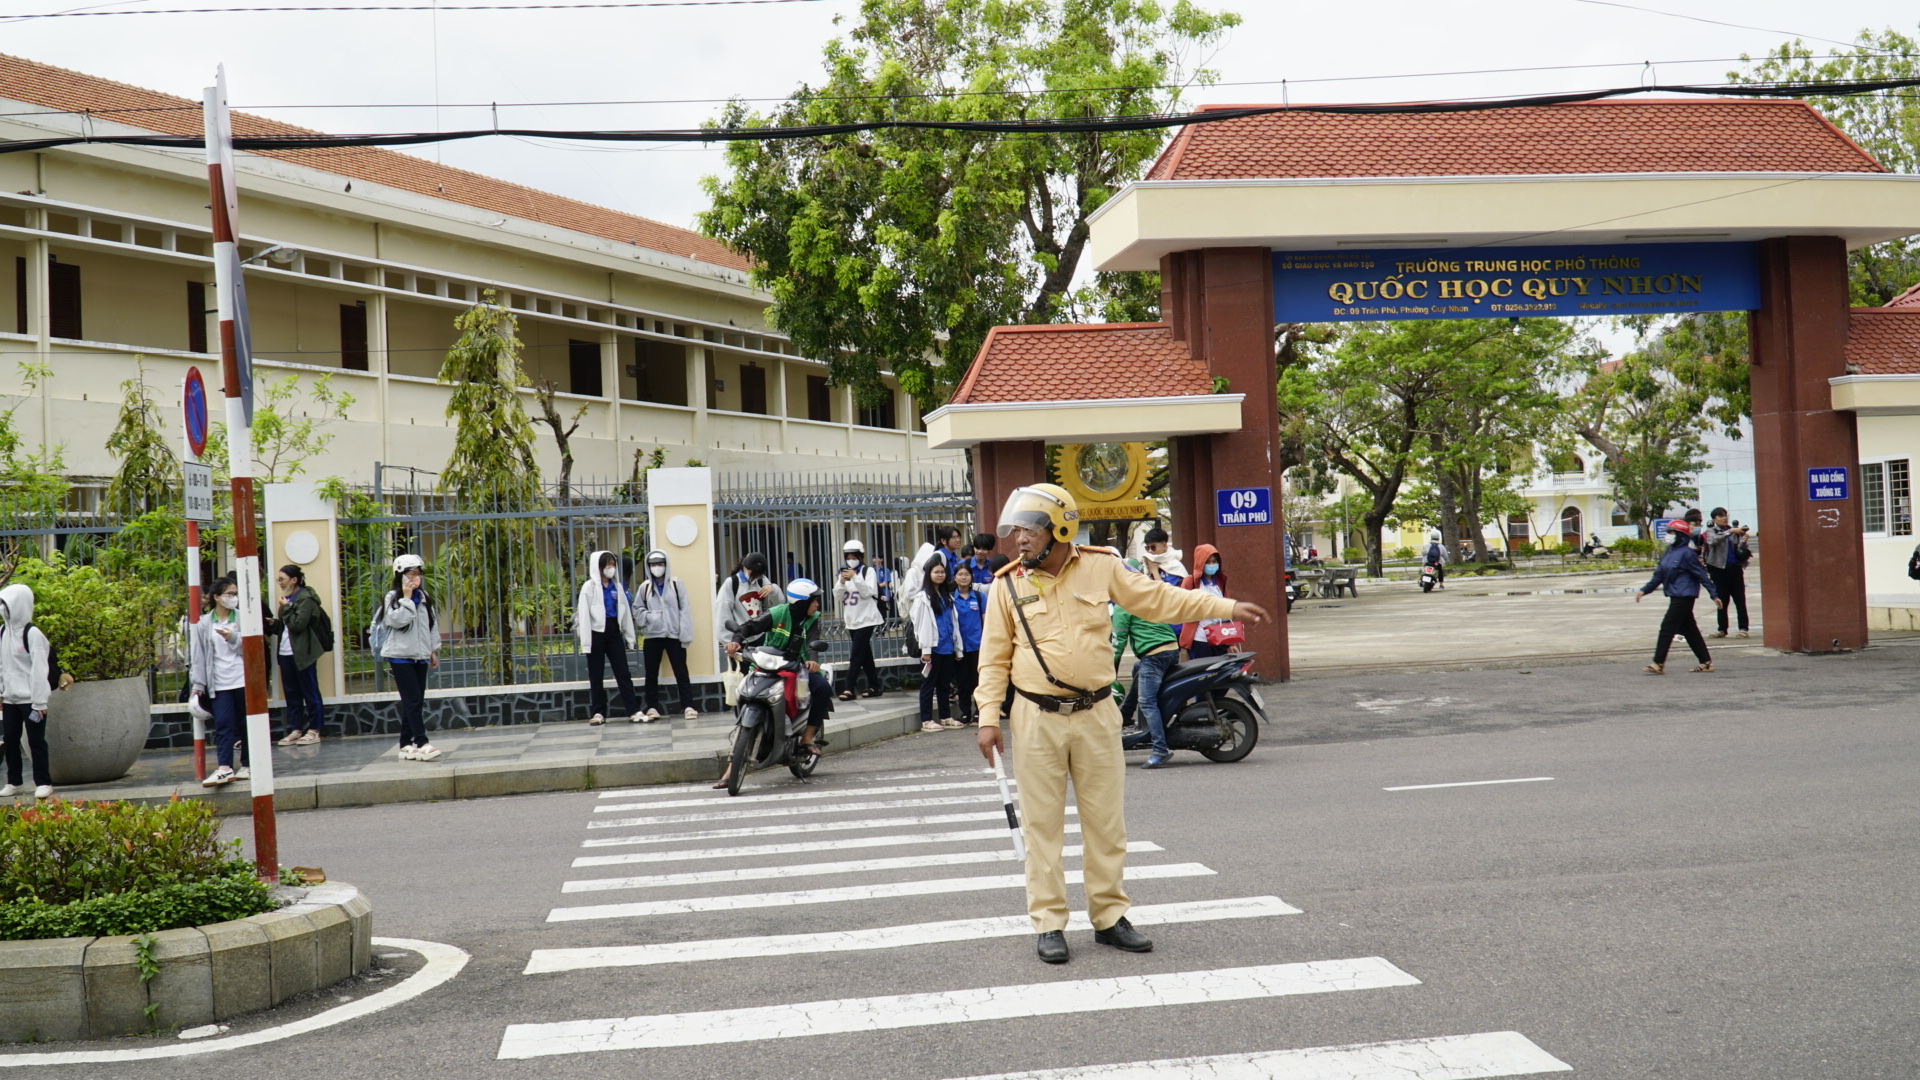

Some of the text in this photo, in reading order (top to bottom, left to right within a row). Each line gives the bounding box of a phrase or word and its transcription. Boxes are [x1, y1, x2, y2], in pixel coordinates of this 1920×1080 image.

[1294, 260, 1312, 269] GIÁO
[1314, 261, 1330, 270] DỤC
[1361, 260, 1375, 269] TẠO
[1395, 255, 1640, 274] TRƯỜNG TRUNG HỌC PHỔ THÔNG
[1328, 273, 1703, 304] QUỐC HỌC QUY NHƠN
[1350, 307, 1360, 315] 09
[1811, 474, 1819, 483] RA
[1819, 472, 1830, 483] VÀO
[1834, 487, 1841, 496] XE
[1230, 491, 1257, 509] 09
[1117, 506, 1129, 516] QUY
[1222, 510, 1267, 524] TRẦN PHÚ
[843, 591, 860, 606] 25
